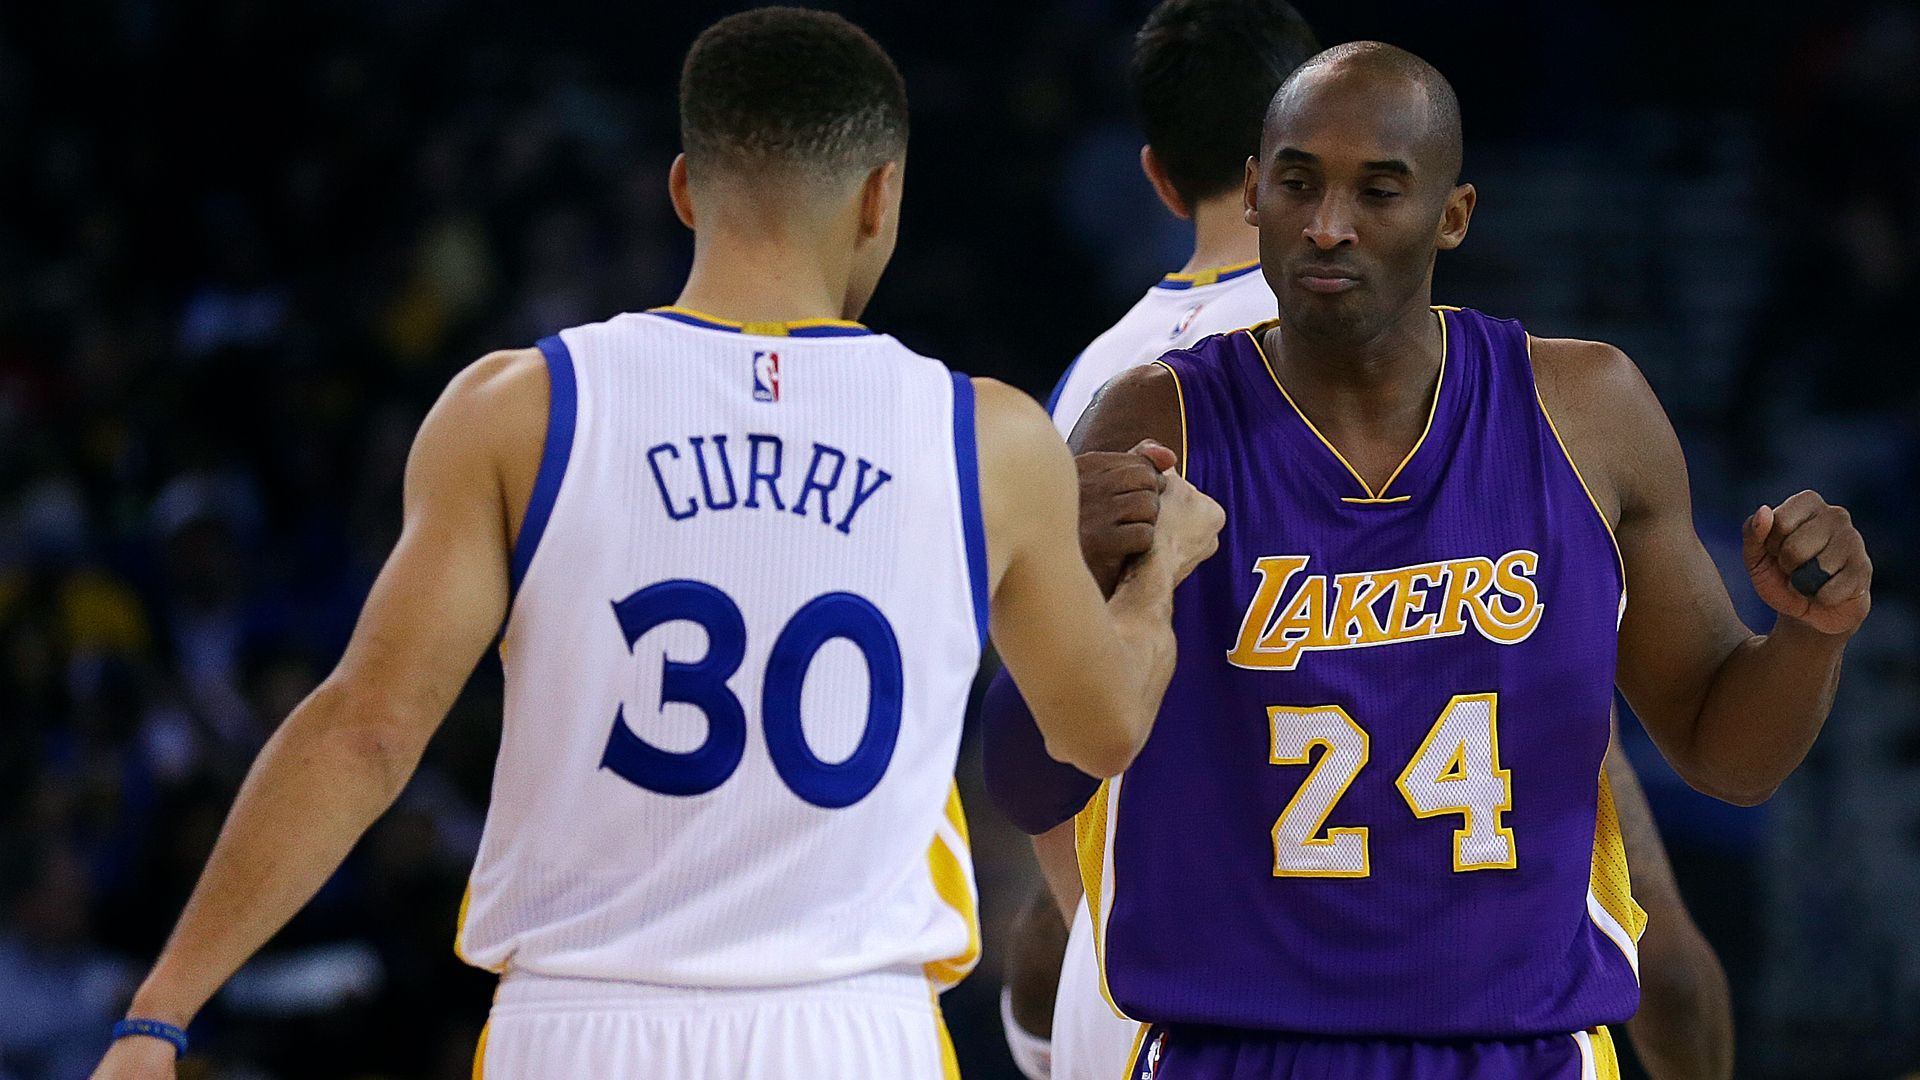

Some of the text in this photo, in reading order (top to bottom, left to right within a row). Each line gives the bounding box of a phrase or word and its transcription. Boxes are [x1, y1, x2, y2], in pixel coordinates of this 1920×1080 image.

[646, 433, 892, 535] CURRY
[1226, 550, 1544, 671] LAKERS
[598, 578, 904, 810] 30
[1266, 692, 1517, 877] 24
